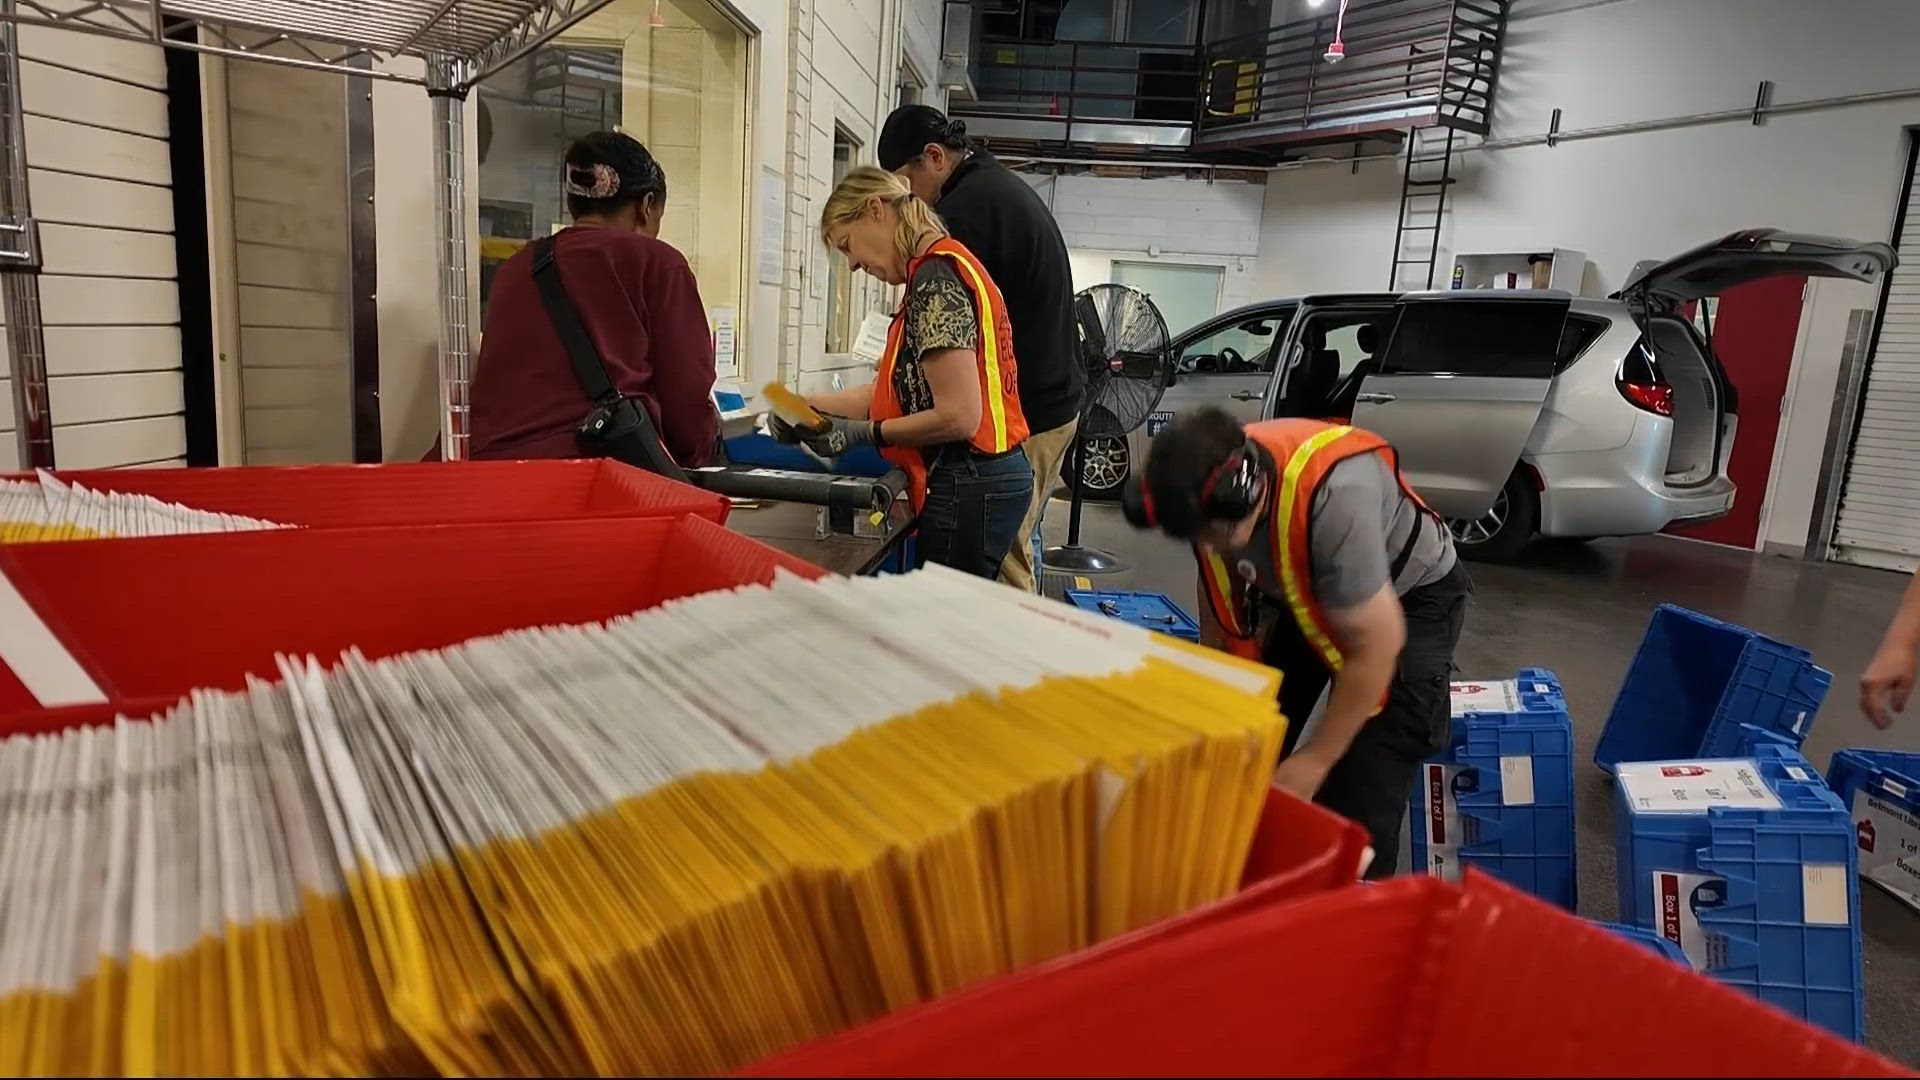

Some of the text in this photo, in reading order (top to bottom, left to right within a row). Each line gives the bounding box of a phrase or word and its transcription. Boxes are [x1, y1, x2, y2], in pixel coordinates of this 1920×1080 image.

[1432, 781, 1441, 797] Box
[1433, 805, 1443, 815] of
[1867, 798, 1904, 821] Belmont
[1907, 843, 1918, 854] of
[1665, 894, 1676, 913] Box
[1667, 923, 1678, 935] of
